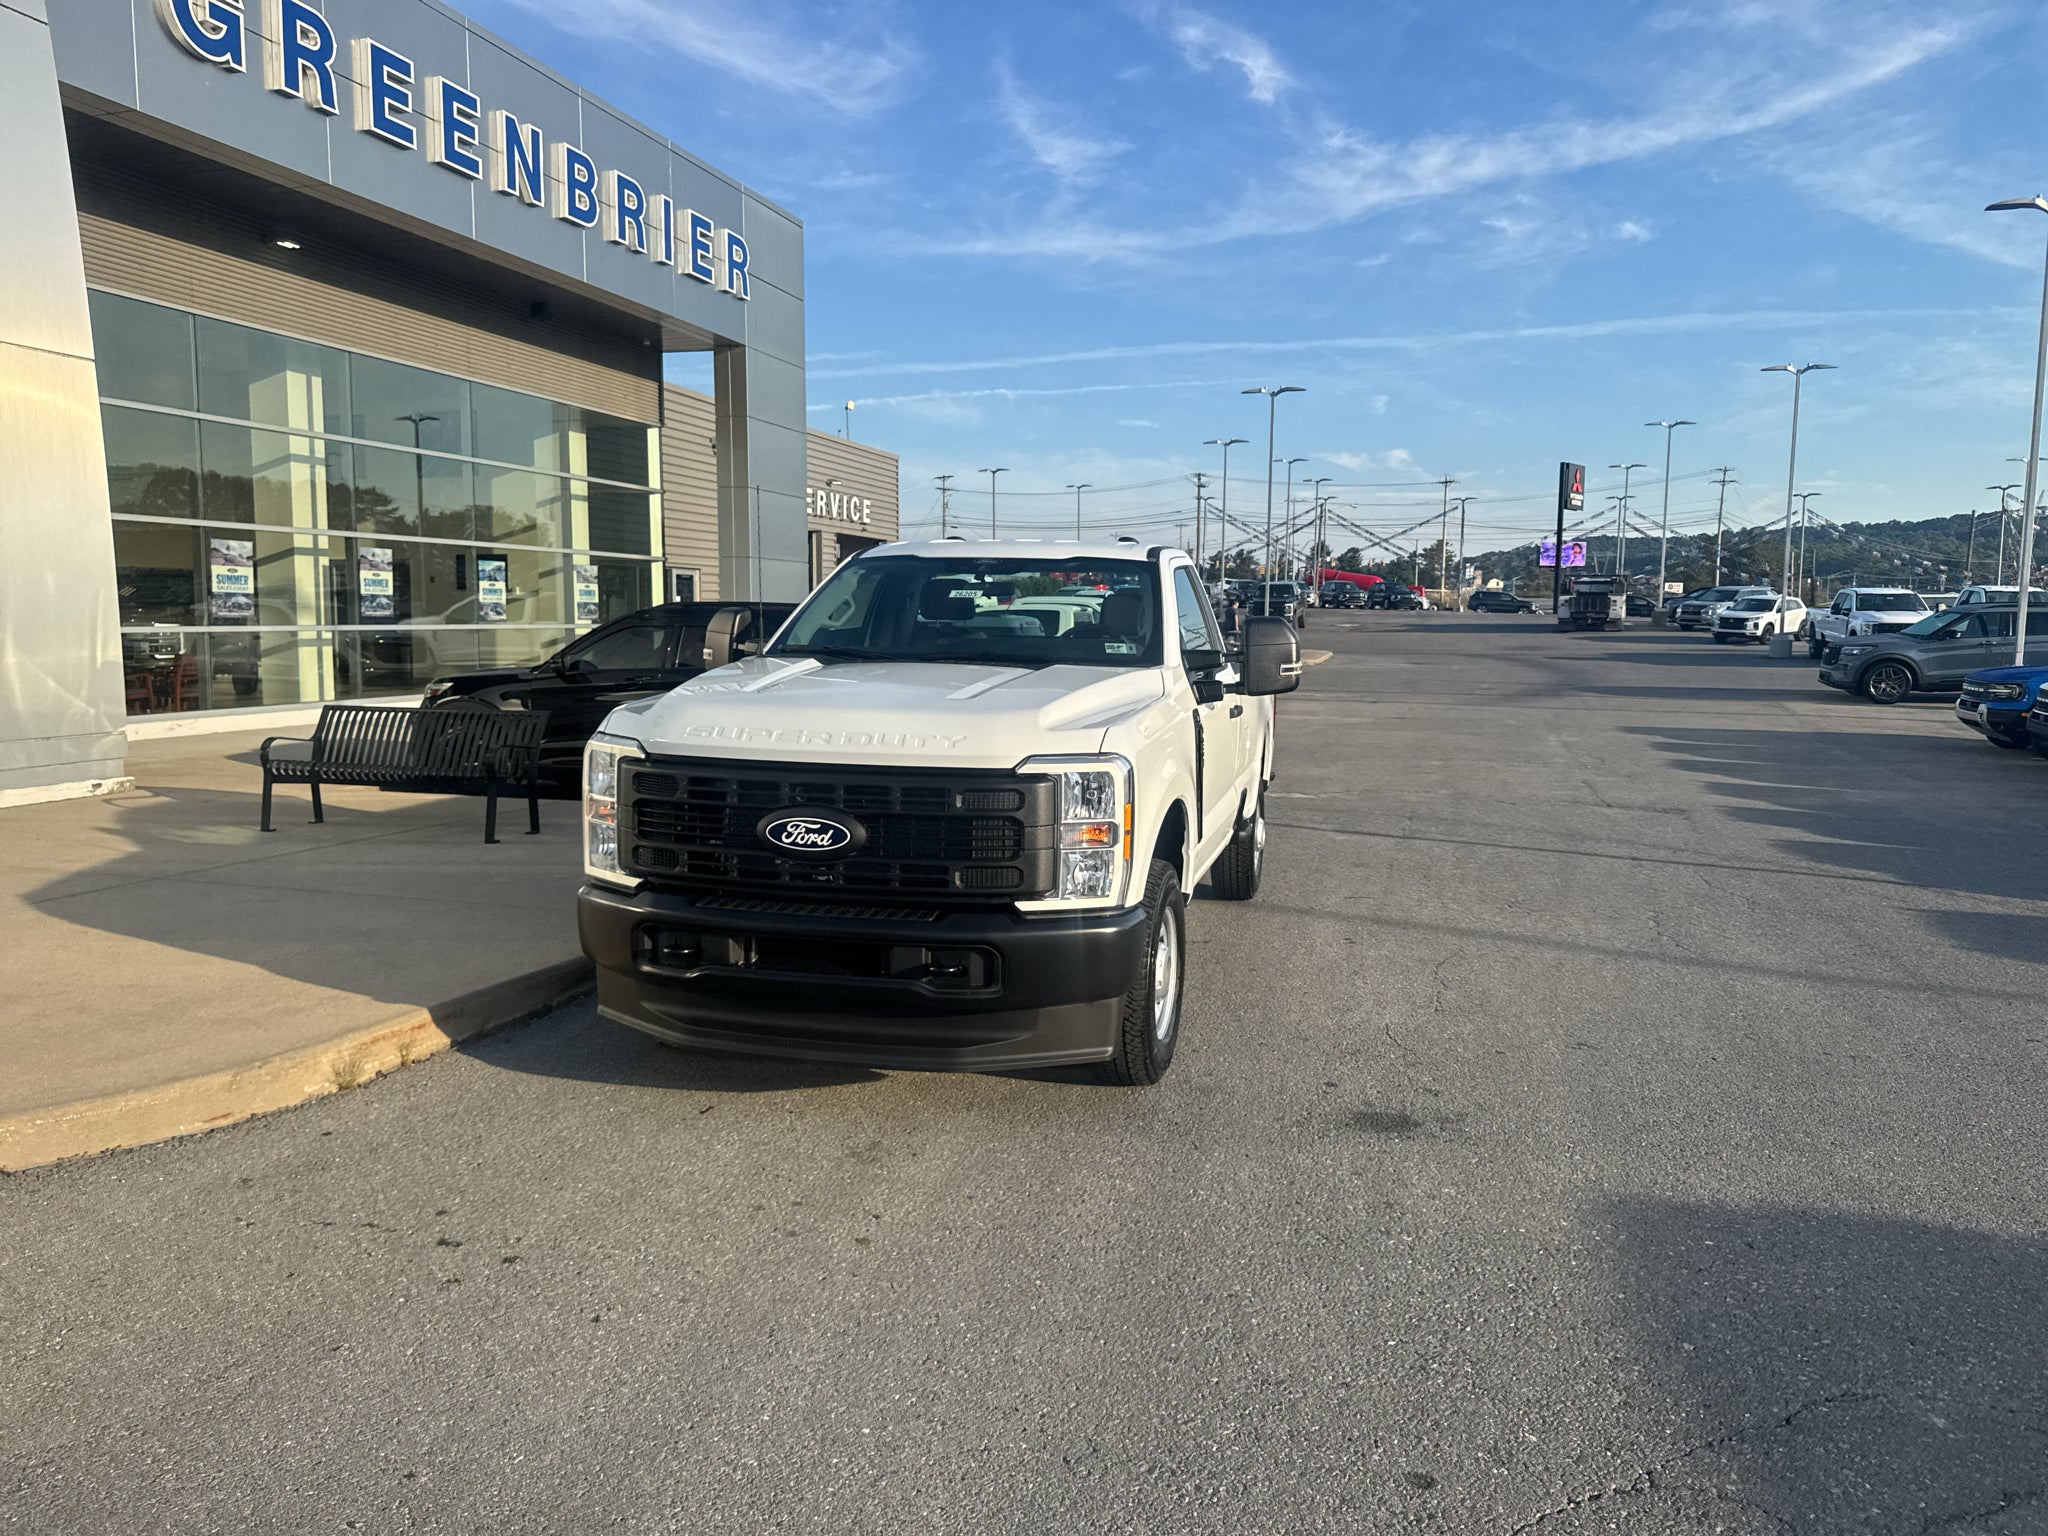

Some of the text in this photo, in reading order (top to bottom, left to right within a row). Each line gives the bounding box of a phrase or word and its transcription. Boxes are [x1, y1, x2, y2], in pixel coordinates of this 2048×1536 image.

[156, 0, 751, 301] GREENBRIER
[806, 487, 871, 524] ERVICE
[216, 573, 249, 586] SUMMER
[363, 577, 389, 588] SUMMER
[683, 724, 967, 749] SUPER DUTY
[781, 821, 834, 846] Ford
